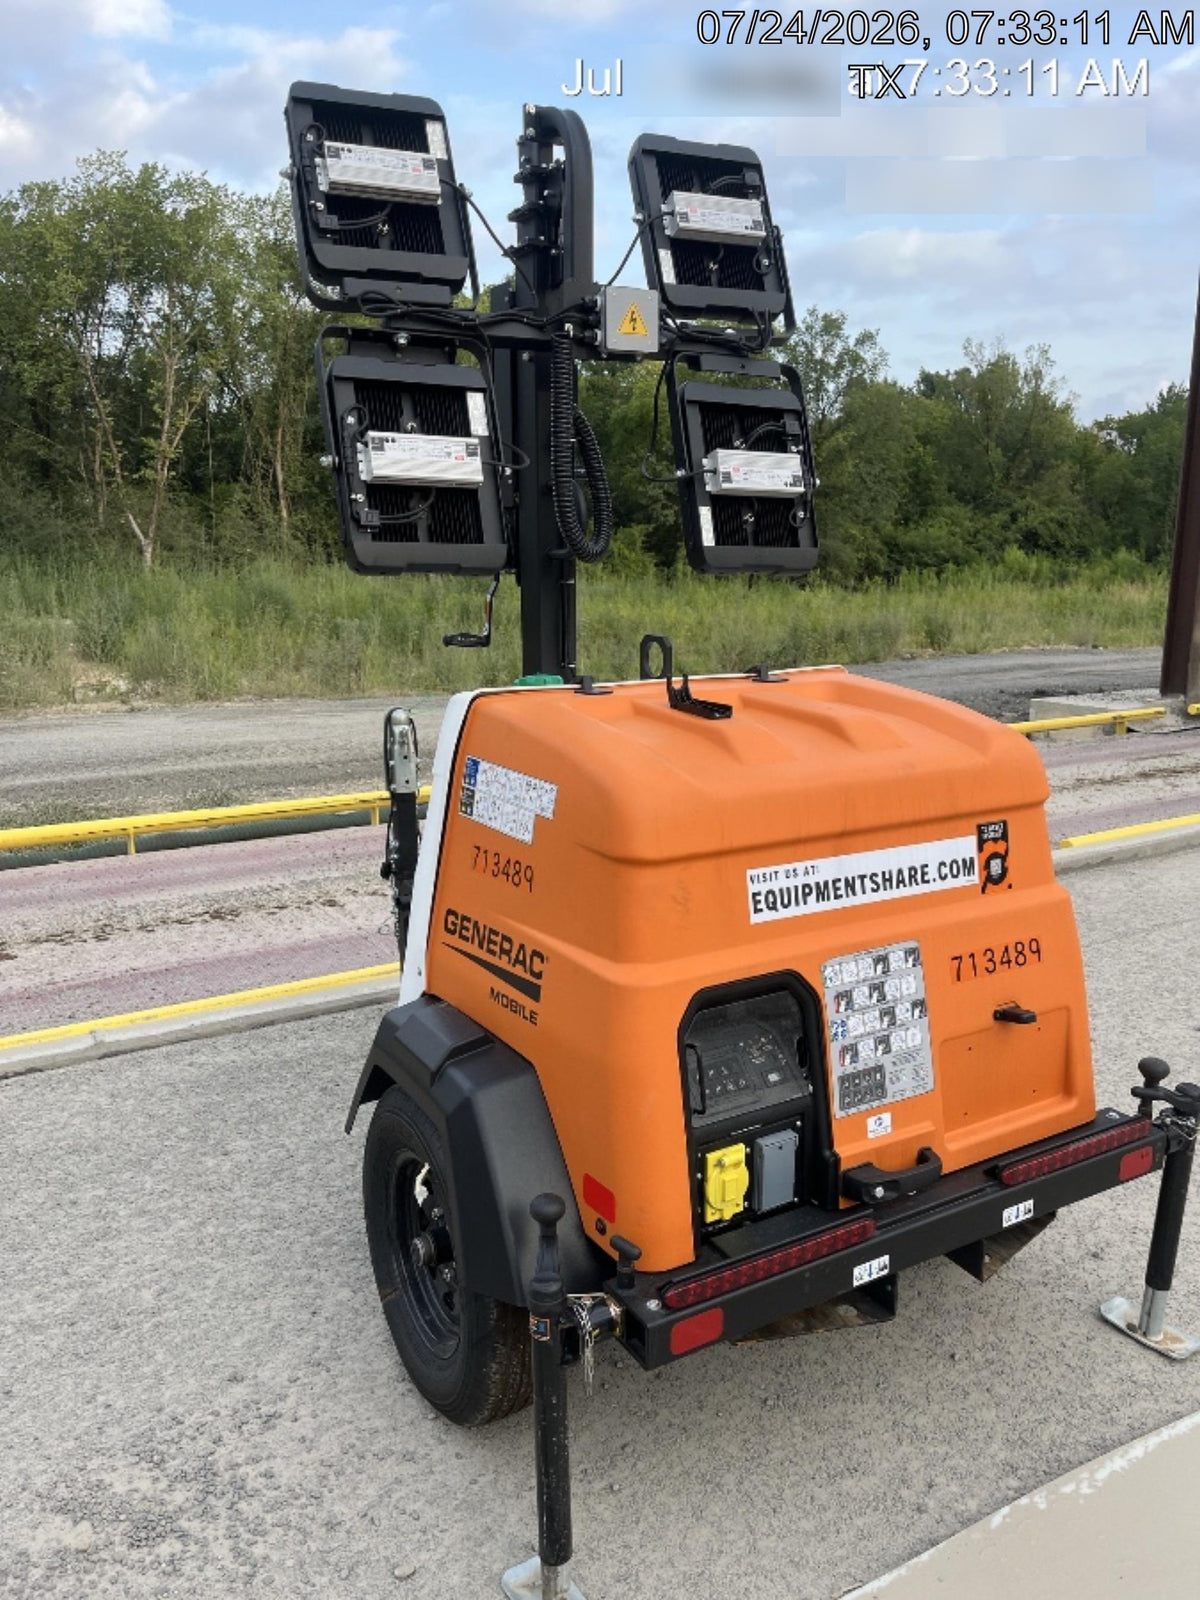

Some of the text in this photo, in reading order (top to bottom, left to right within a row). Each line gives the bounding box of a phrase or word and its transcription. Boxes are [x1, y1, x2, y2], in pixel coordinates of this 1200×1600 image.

[470, 845, 535, 893] 713489
[749, 871, 780, 885] VISIT
[784, 867, 799, 879] US
[751, 855, 976, 915] EQUIPMENTSHARE.COM
[443, 907, 545, 981] GENERAC
[950, 937, 1042, 982] 713489
[489, 986, 538, 1027] MOBILE
